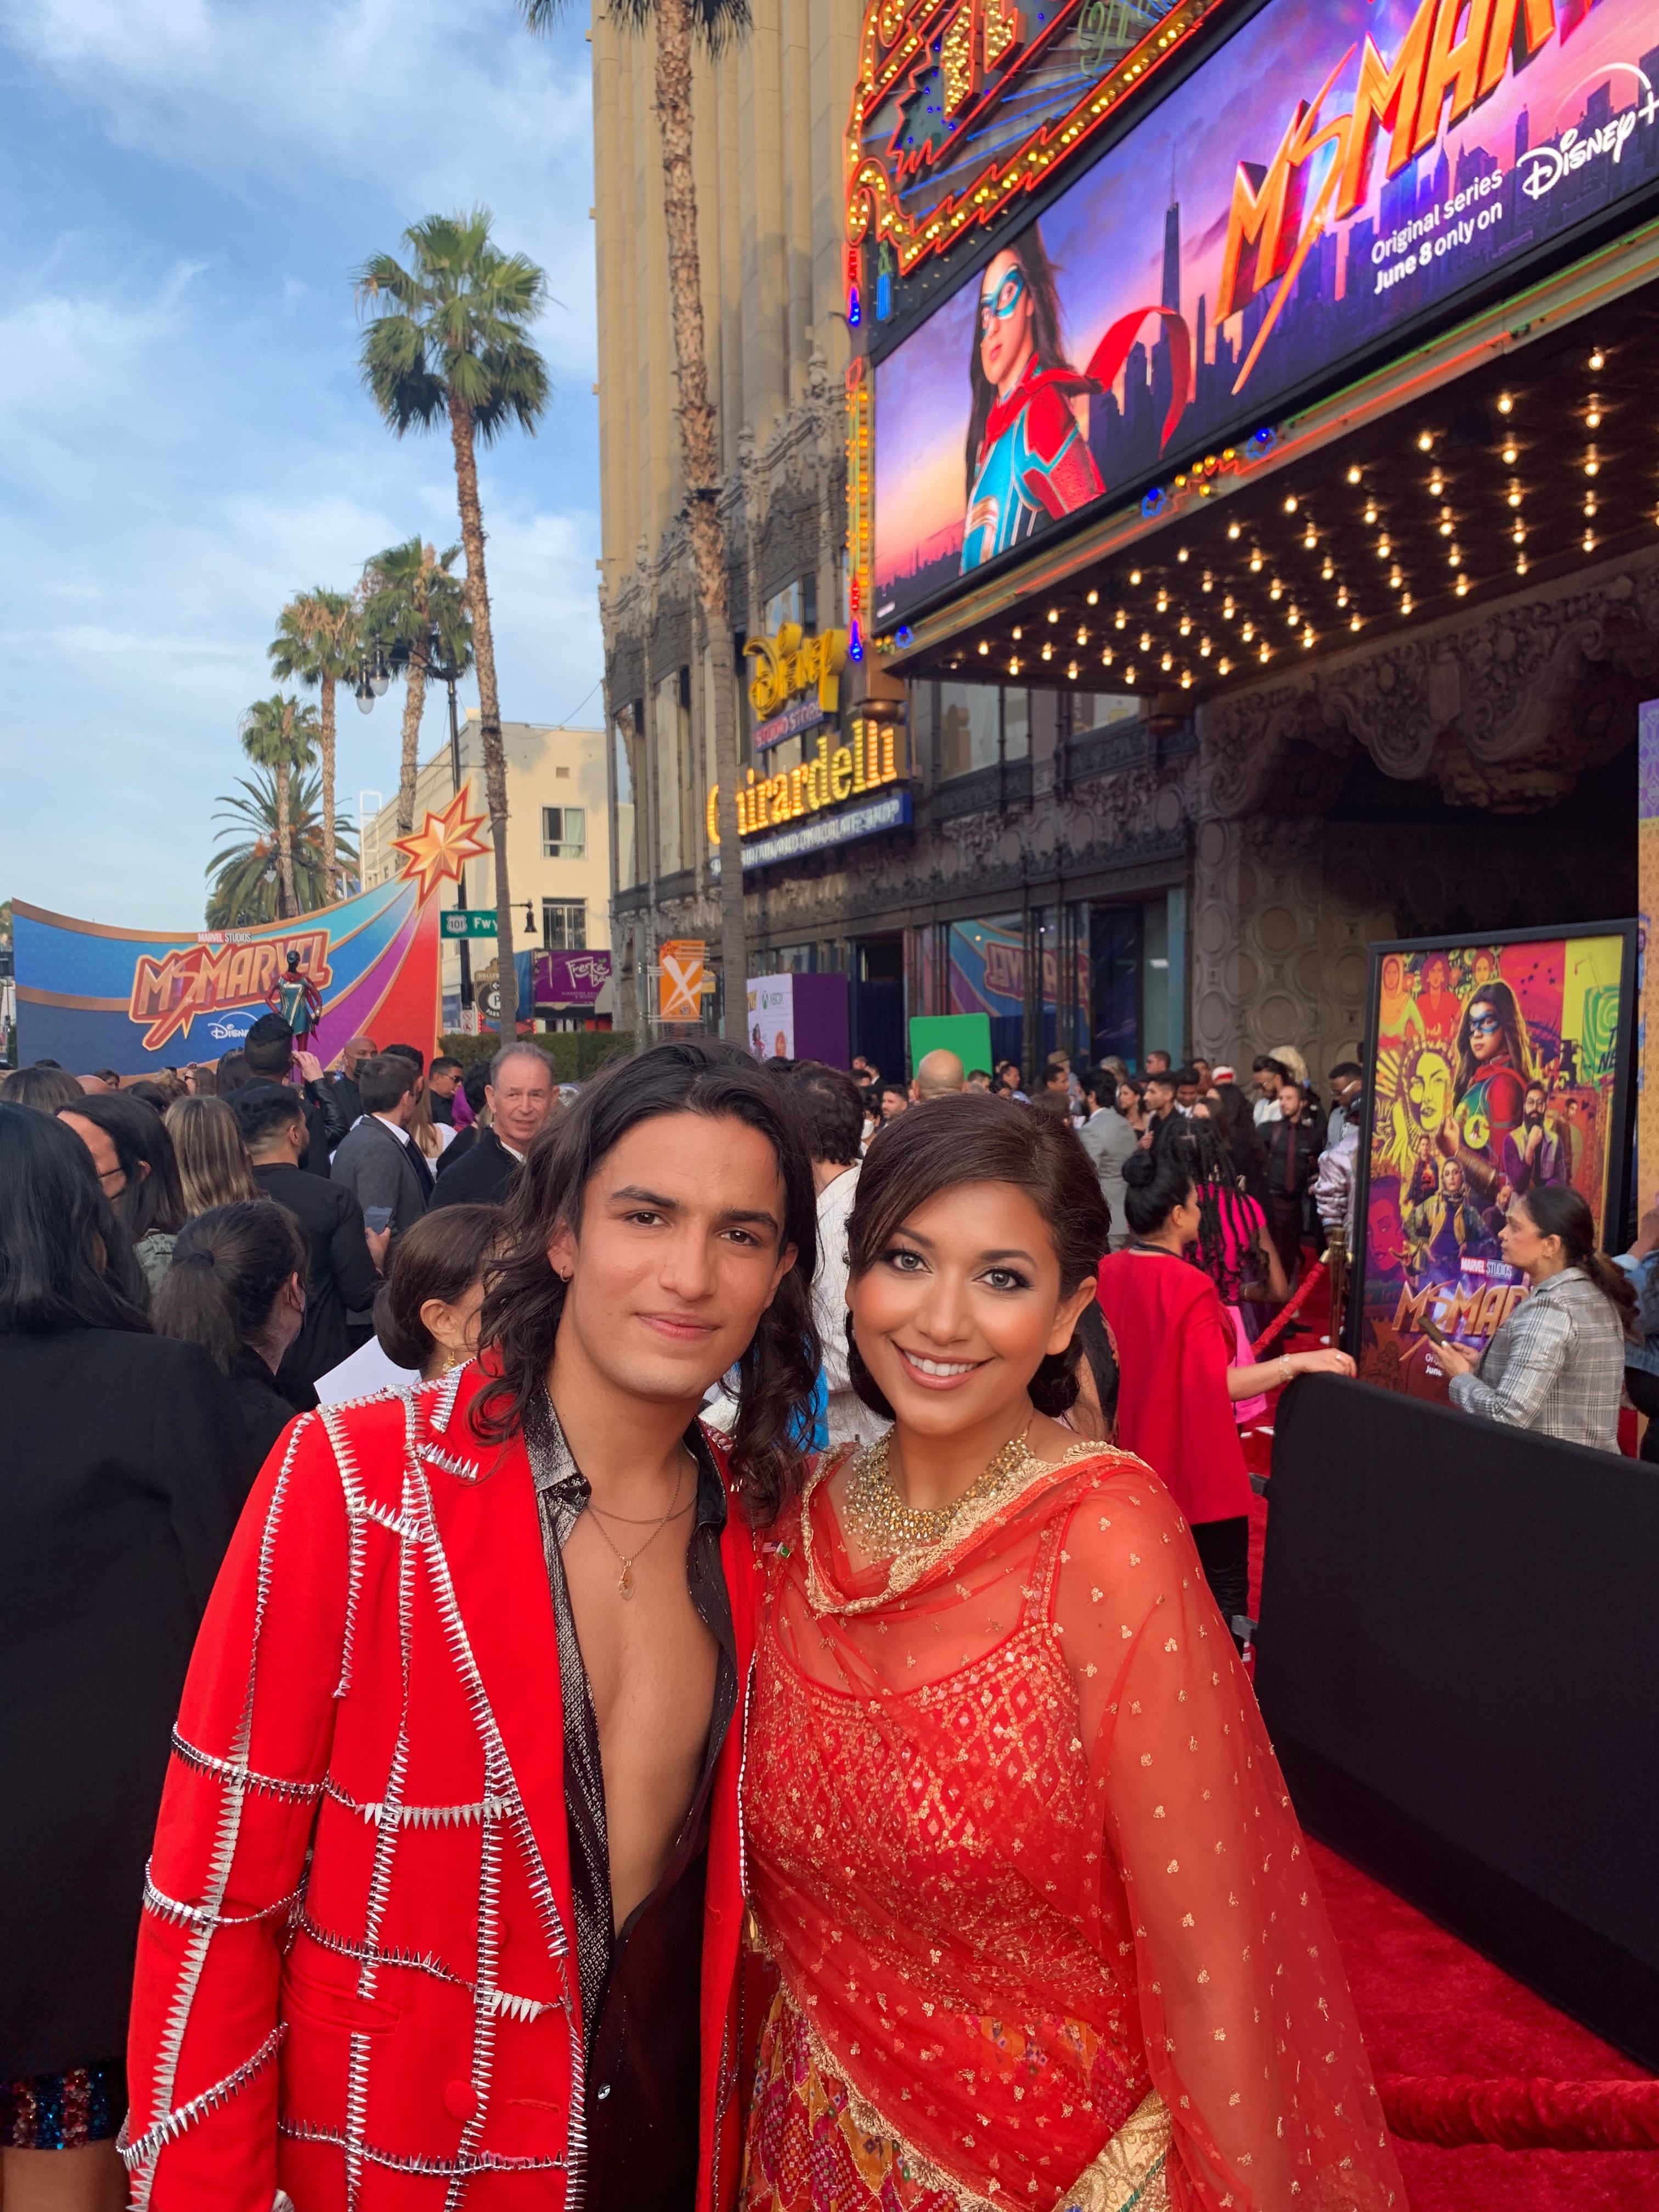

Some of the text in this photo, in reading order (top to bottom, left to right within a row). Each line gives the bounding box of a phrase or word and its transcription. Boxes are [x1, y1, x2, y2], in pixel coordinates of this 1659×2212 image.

[1372, 204, 1440, 264] Original
[1443, 169, 1503, 219] series
[1374, 202, 1503, 295] June 8 only on
[198, 933, 251, 943] MARVEL STUDIOS
[450, 920, 463, 929] 101
[195, 935, 325, 1005] MARVEL
[1461, 1257, 1513, 1277] MARVEL STUDIOS
